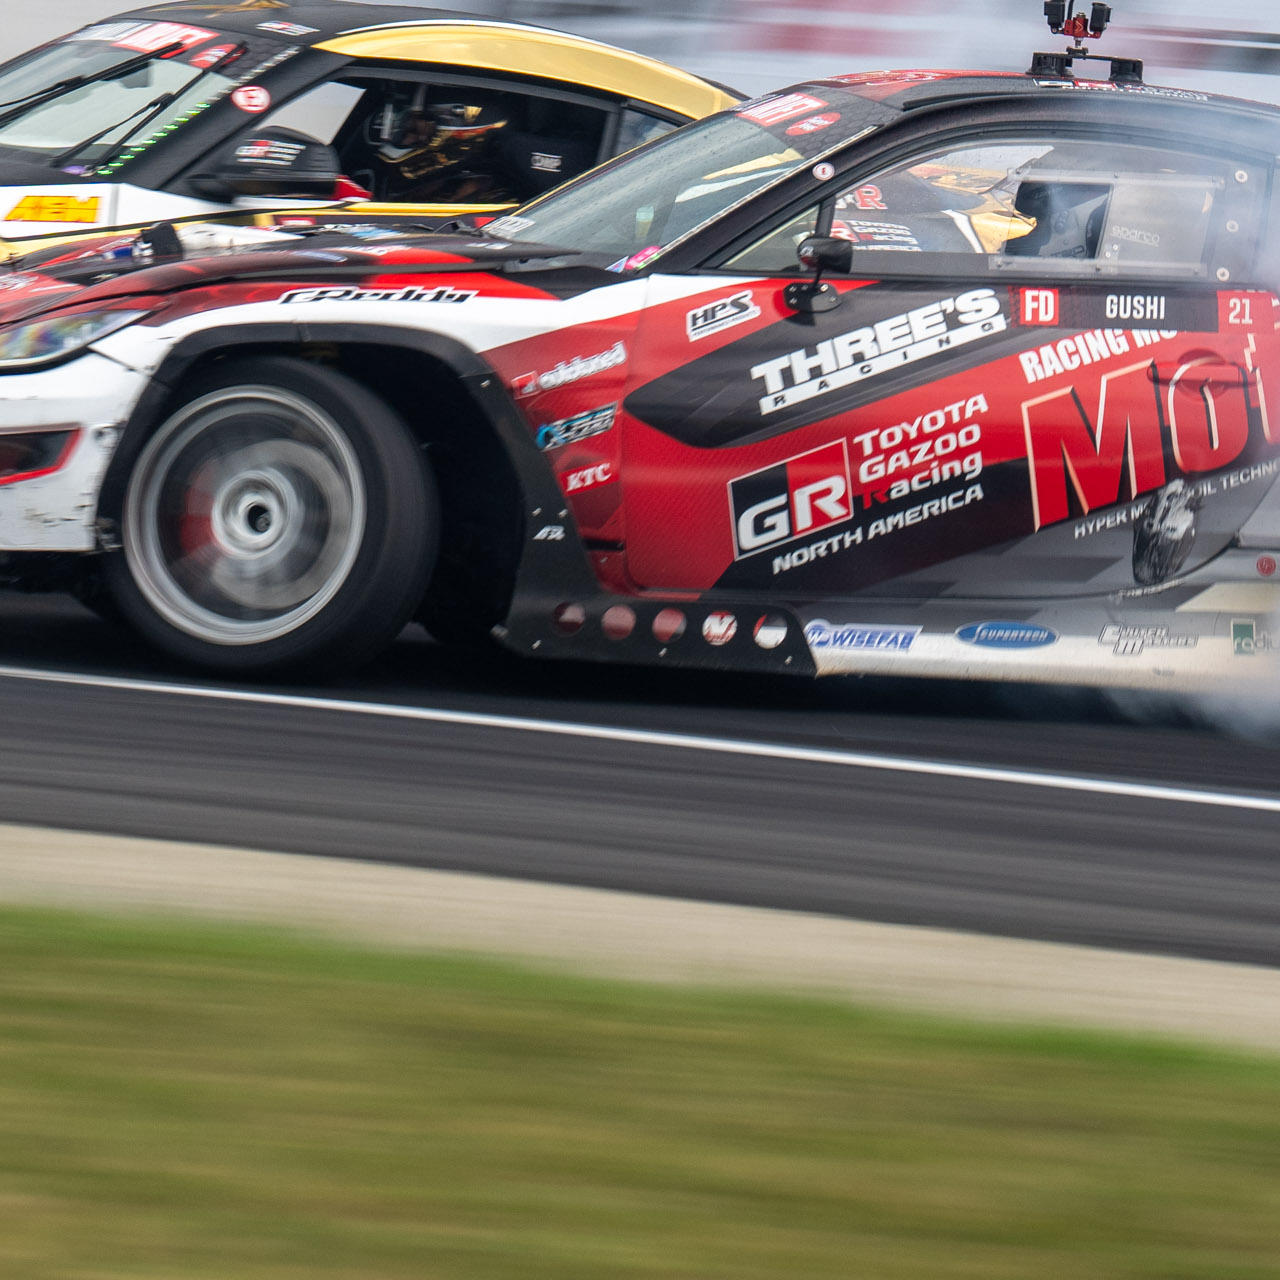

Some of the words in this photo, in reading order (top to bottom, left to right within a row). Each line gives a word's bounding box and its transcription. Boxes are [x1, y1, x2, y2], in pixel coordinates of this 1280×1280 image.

[1111, 224, 1160, 245] sparco
[691, 292, 751, 329] HPS
[1025, 289, 1055, 322] FD
[1105, 294, 1166, 320] GUSHI
[1228, 297, 1254, 325] 21
[750, 288, 1001, 396] THREE'S
[773, 320, 994, 408] RACING
[1019, 328, 1131, 384] RACING
[853, 393, 989, 458] TOYOTA
[858, 423, 982, 484] GAZOO
[566, 462, 612, 492] KTC
[861, 450, 983, 510] Racing
[737, 474, 849, 551] GR
[772, 526, 863, 575] NORTH
[867, 483, 984, 541] AMERICA
[1074, 511, 1127, 539] HYPER
